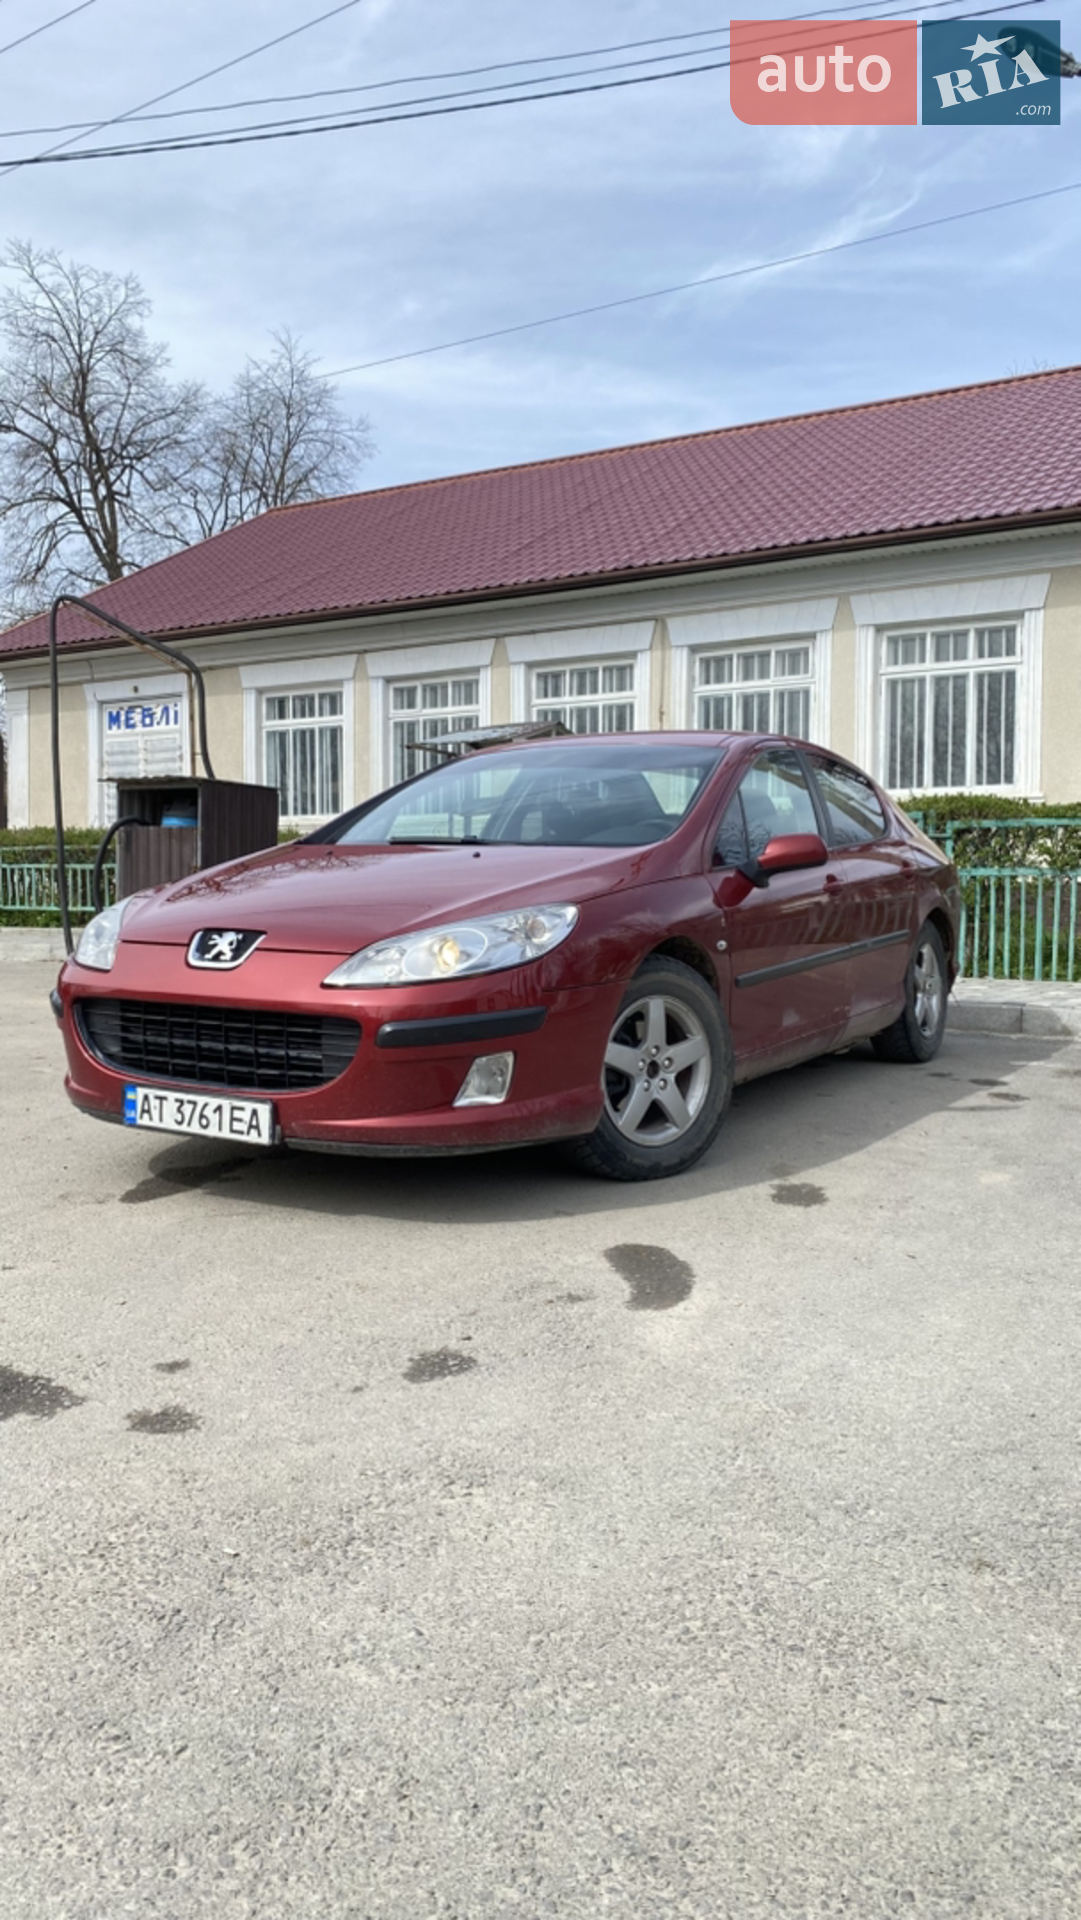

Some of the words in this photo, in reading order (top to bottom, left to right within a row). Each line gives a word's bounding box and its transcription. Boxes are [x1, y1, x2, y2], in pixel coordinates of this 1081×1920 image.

[139, 1094, 168, 1123] AT
[174, 1098, 223, 1132] 3761
[229, 1106, 262, 1138] EA
